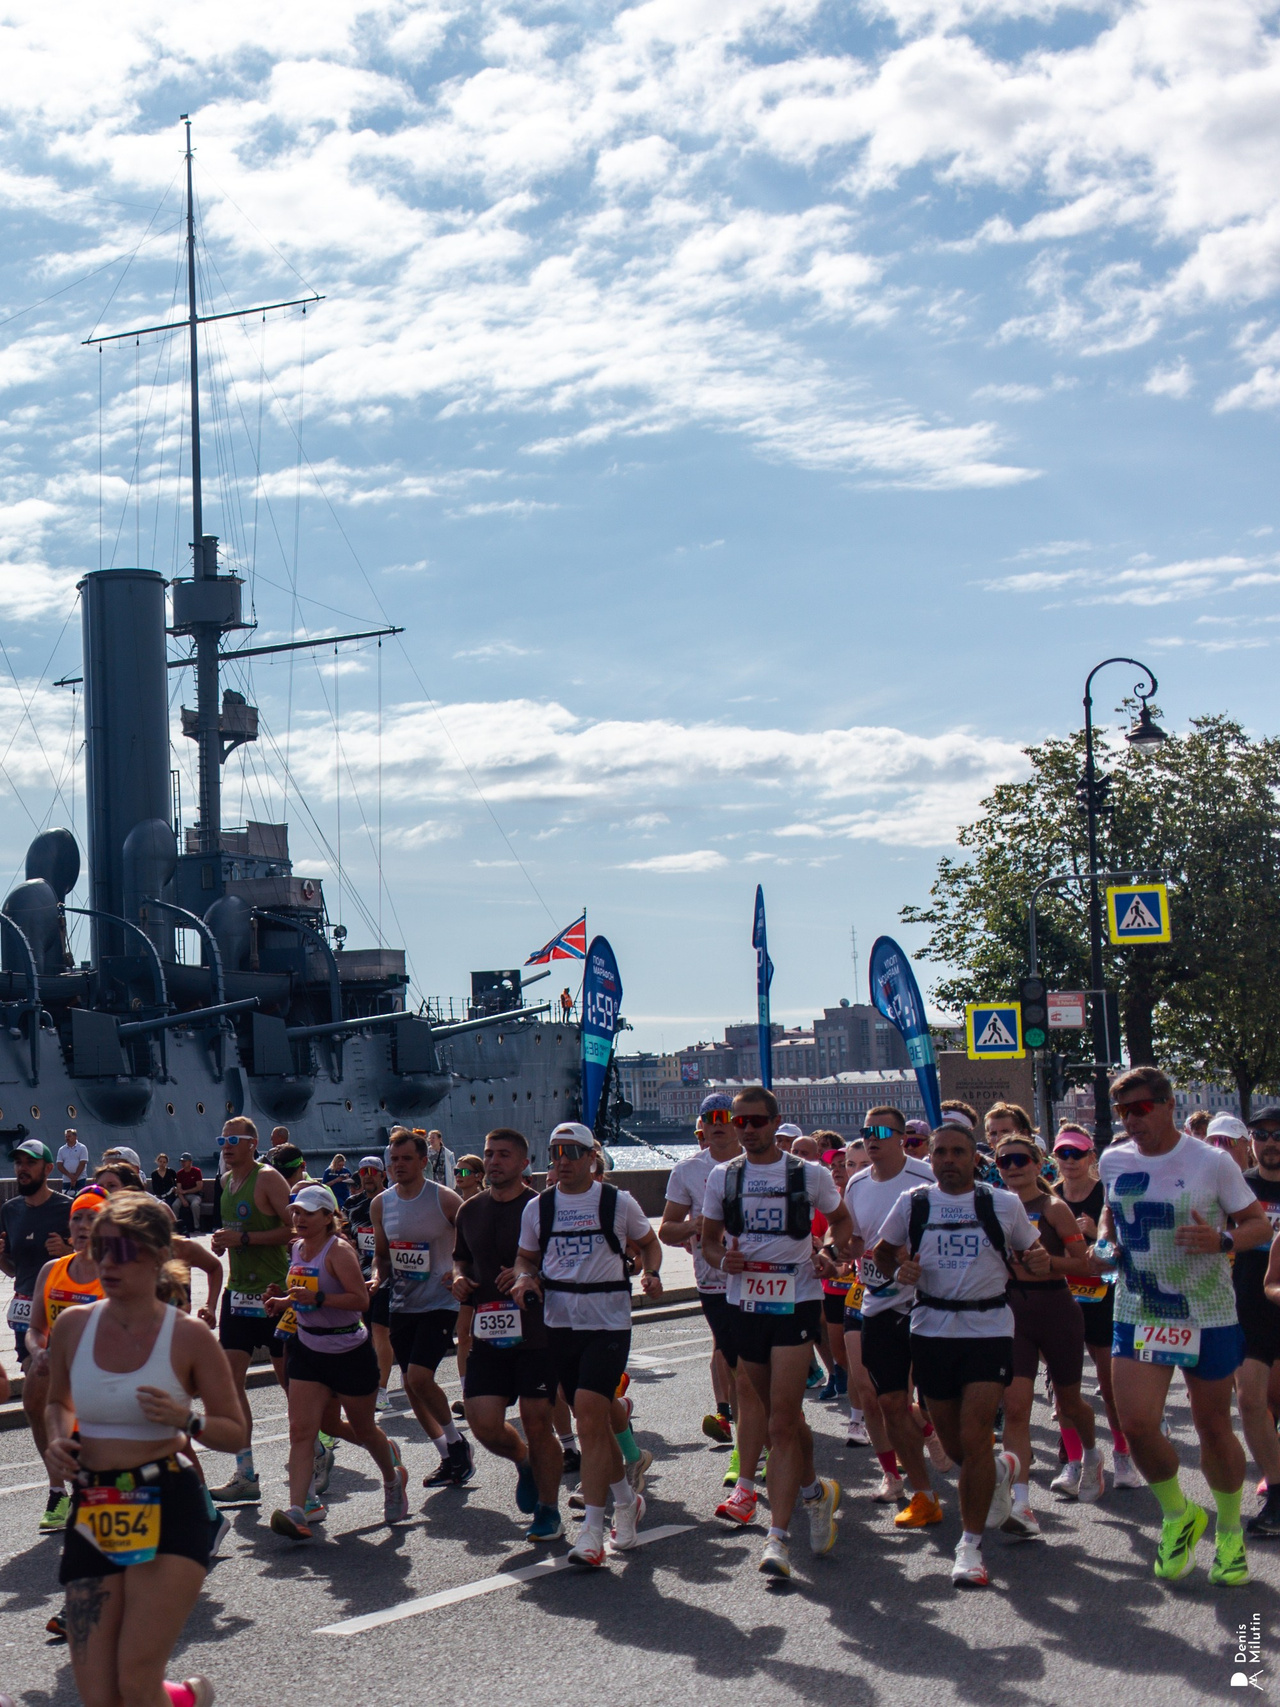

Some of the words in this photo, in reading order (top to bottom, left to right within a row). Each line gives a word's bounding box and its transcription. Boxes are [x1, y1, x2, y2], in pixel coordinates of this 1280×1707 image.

[587, 991, 613, 1031] 1:59
[962, 1091, 1005, 1100] АВРОРА
[557, 1209, 577, 1217] ПОЛУ
[940, 1206, 964, 1214] ПОЛУ
[557, 1214, 595, 1222] МАРАФОН
[744, 1208, 783, 1231] 1:59
[555, 1234, 592, 1257] 1:59
[938, 1234, 979, 1258] 1:59
[395, 1252, 424, 1266] 4046
[938, 1260, 958, 1270] 5:38
[746, 1278, 787, 1296] 7617
[746, 1301, 753, 1311] E
[480, 1314, 516, 1330] 5352
[1143, 1325, 1192, 1347] 7459
[1142, 1350, 1150, 1361] E
[88, 1510, 149, 1538] 1054
